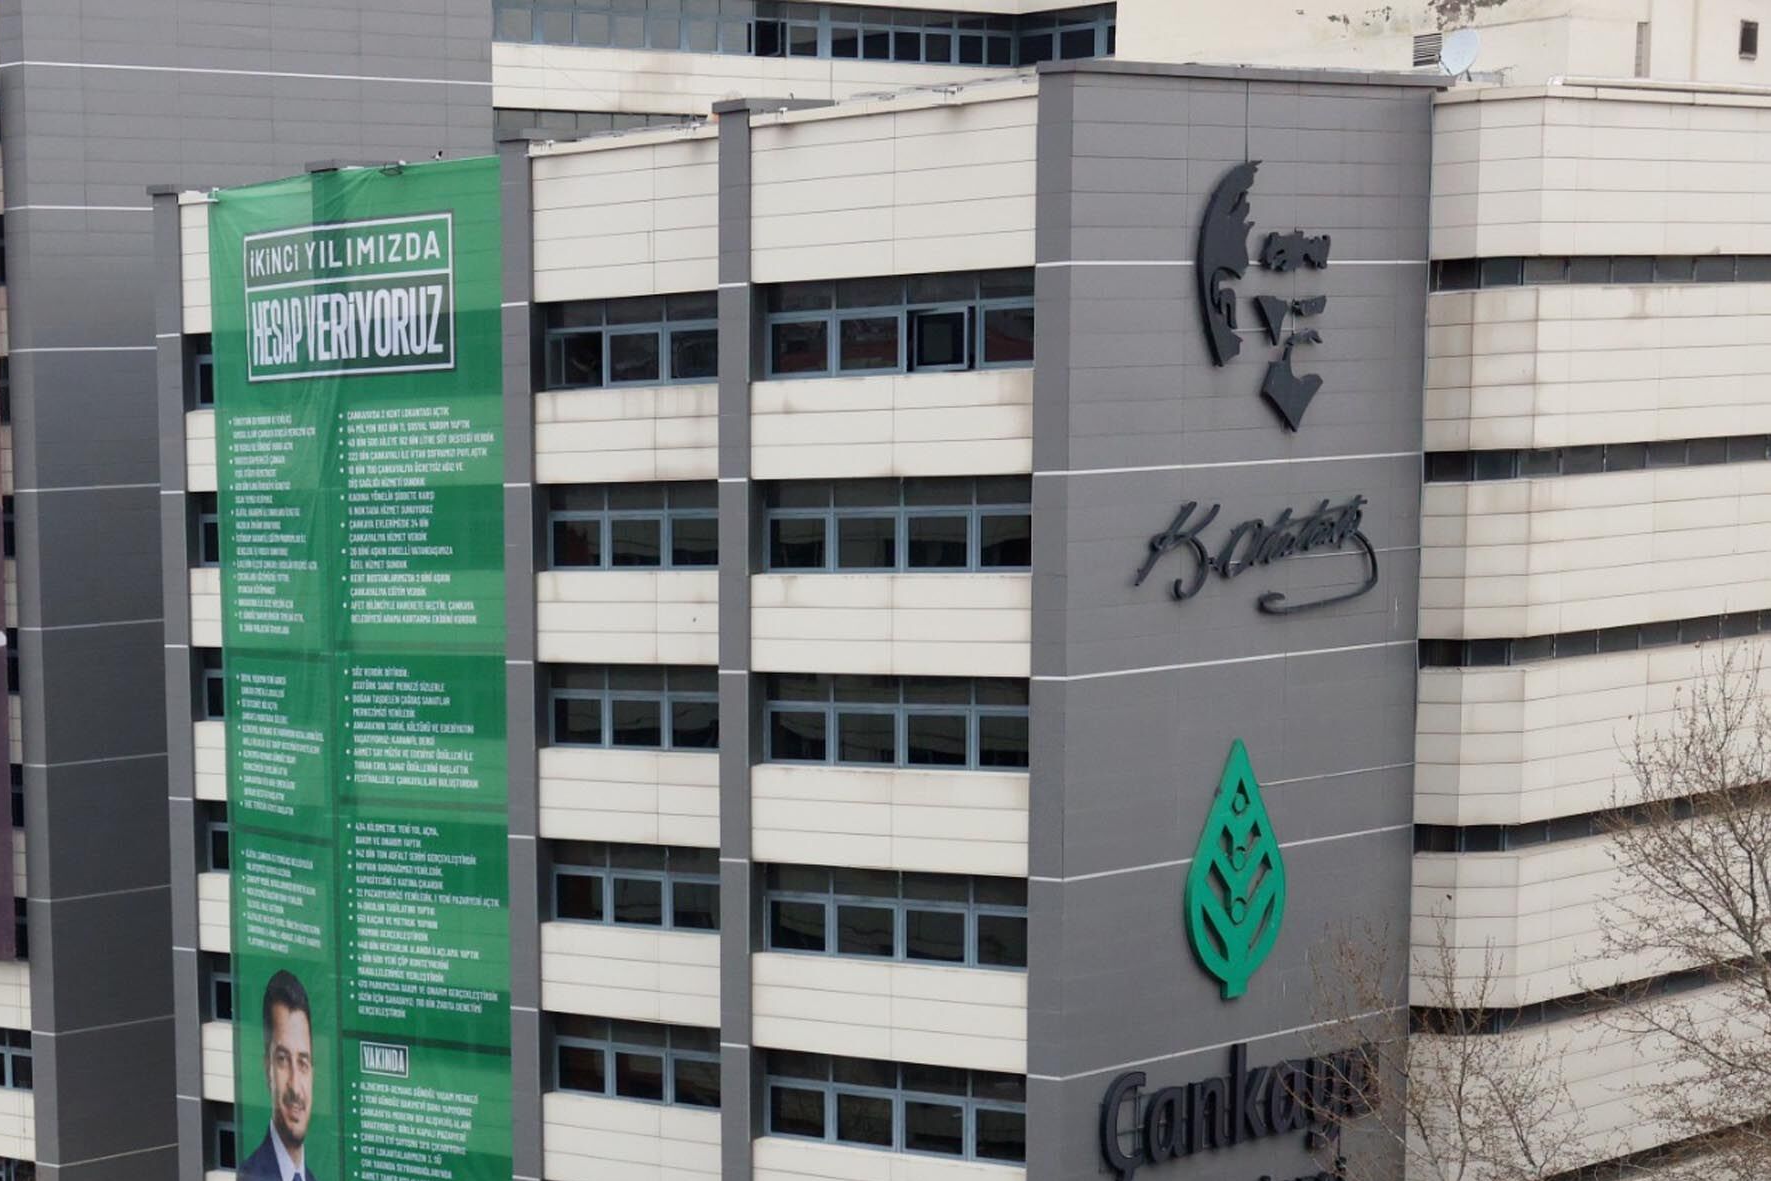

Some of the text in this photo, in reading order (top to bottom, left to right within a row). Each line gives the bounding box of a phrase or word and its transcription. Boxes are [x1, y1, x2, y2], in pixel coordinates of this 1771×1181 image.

[249, 230, 441, 278] İKİNCİ YILIMIZDA
[252, 284, 444, 367] HESAP VERİYORUZ
[364, 1046, 406, 1073] YAKINDA
